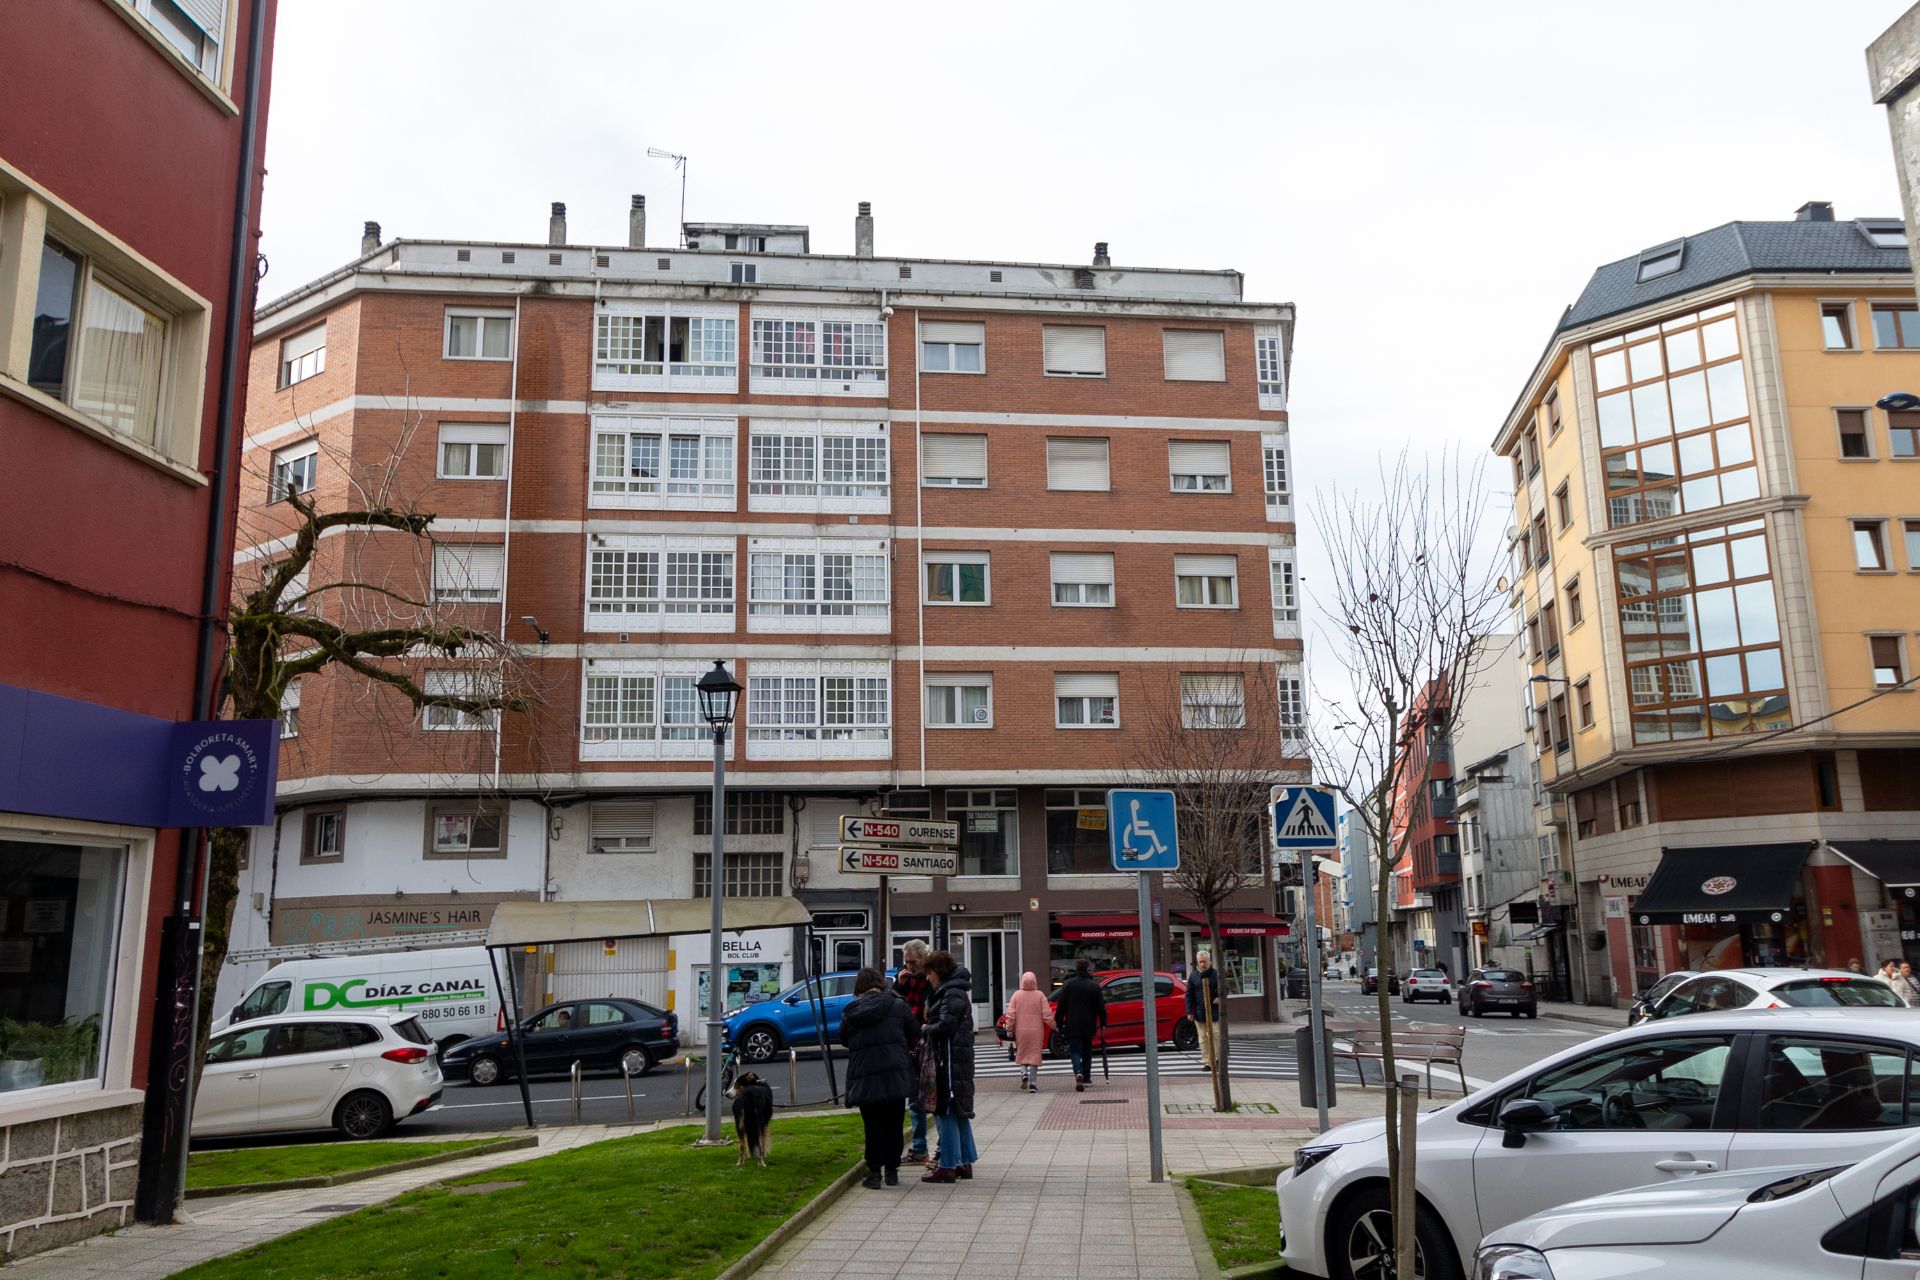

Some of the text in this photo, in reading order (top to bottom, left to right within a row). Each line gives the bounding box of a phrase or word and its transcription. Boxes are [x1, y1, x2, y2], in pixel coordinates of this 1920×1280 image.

[183, 733, 258, 772] BOLBORETA SMART
[864, 824, 955, 839] N-540 OURENSE
[863, 854, 954, 869] N-540 SANTIAGO
[448, 910, 481, 923] HAIR
[1683, 913, 1717, 924] UMBAR
[367, 985, 413, 999] DÍAZ
[418, 979, 485, 993] CANAL
[422, 1004, 486, 1020] 680 50 66 18
